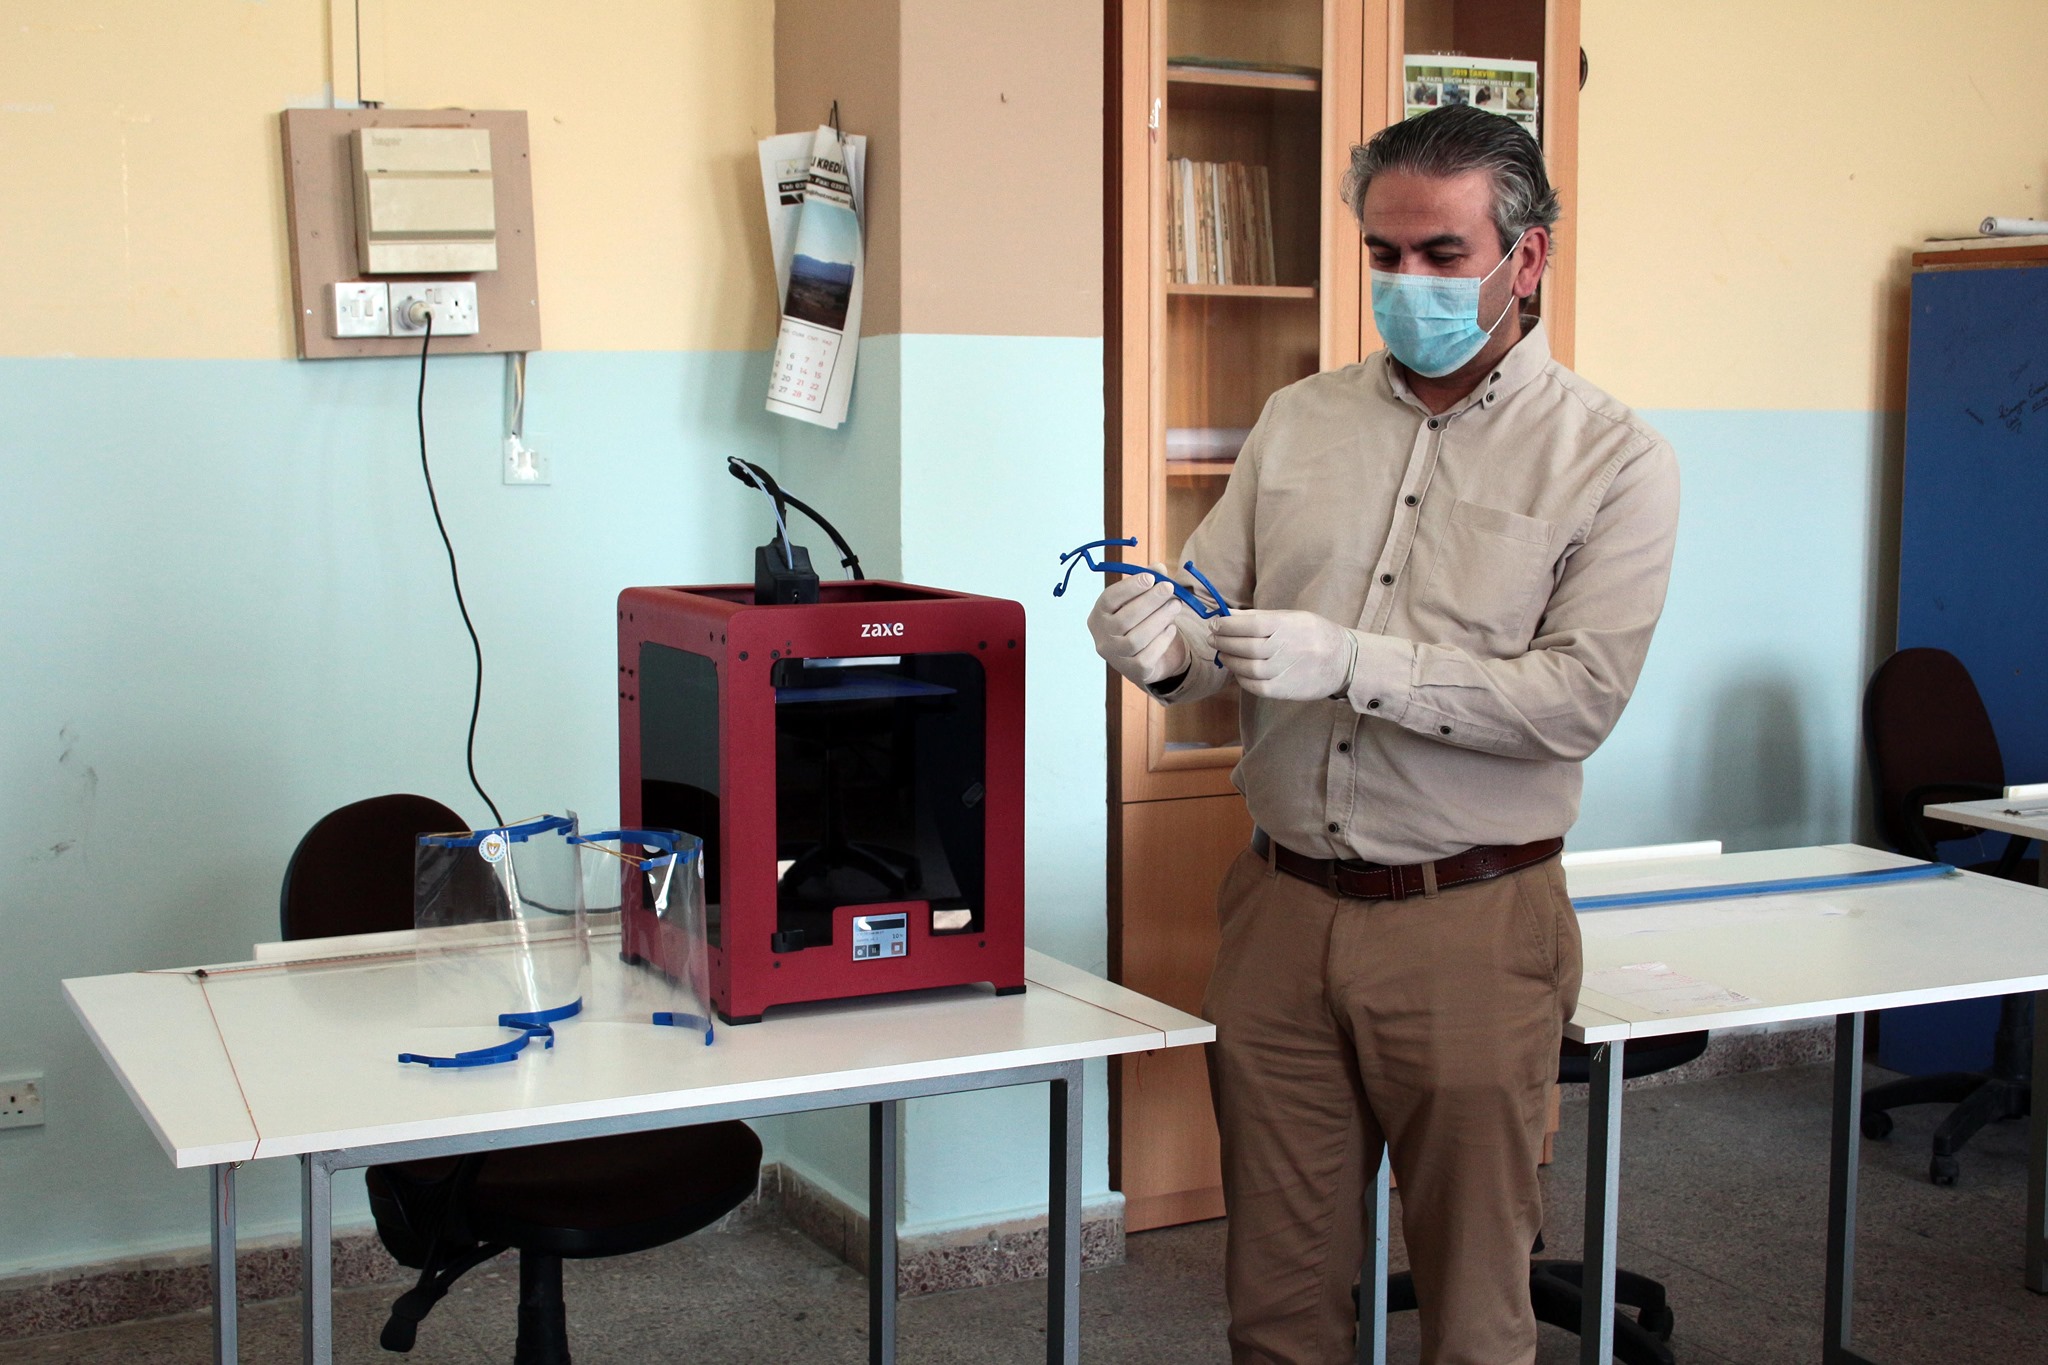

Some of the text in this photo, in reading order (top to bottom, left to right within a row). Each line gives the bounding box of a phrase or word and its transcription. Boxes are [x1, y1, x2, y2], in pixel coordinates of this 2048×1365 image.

[1452, 68, 1468, 77] 2019
[785, 363, 793, 371] 13
[799, 367, 808, 375] 14
[814, 371, 822, 379] 15
[781, 374, 791, 383] 20
[809, 383, 819, 391] 22
[778, 386, 788, 394] 27
[792, 390, 802, 398] 28
[806, 394, 817, 402] 29
[860, 622, 905, 638] zaxe
